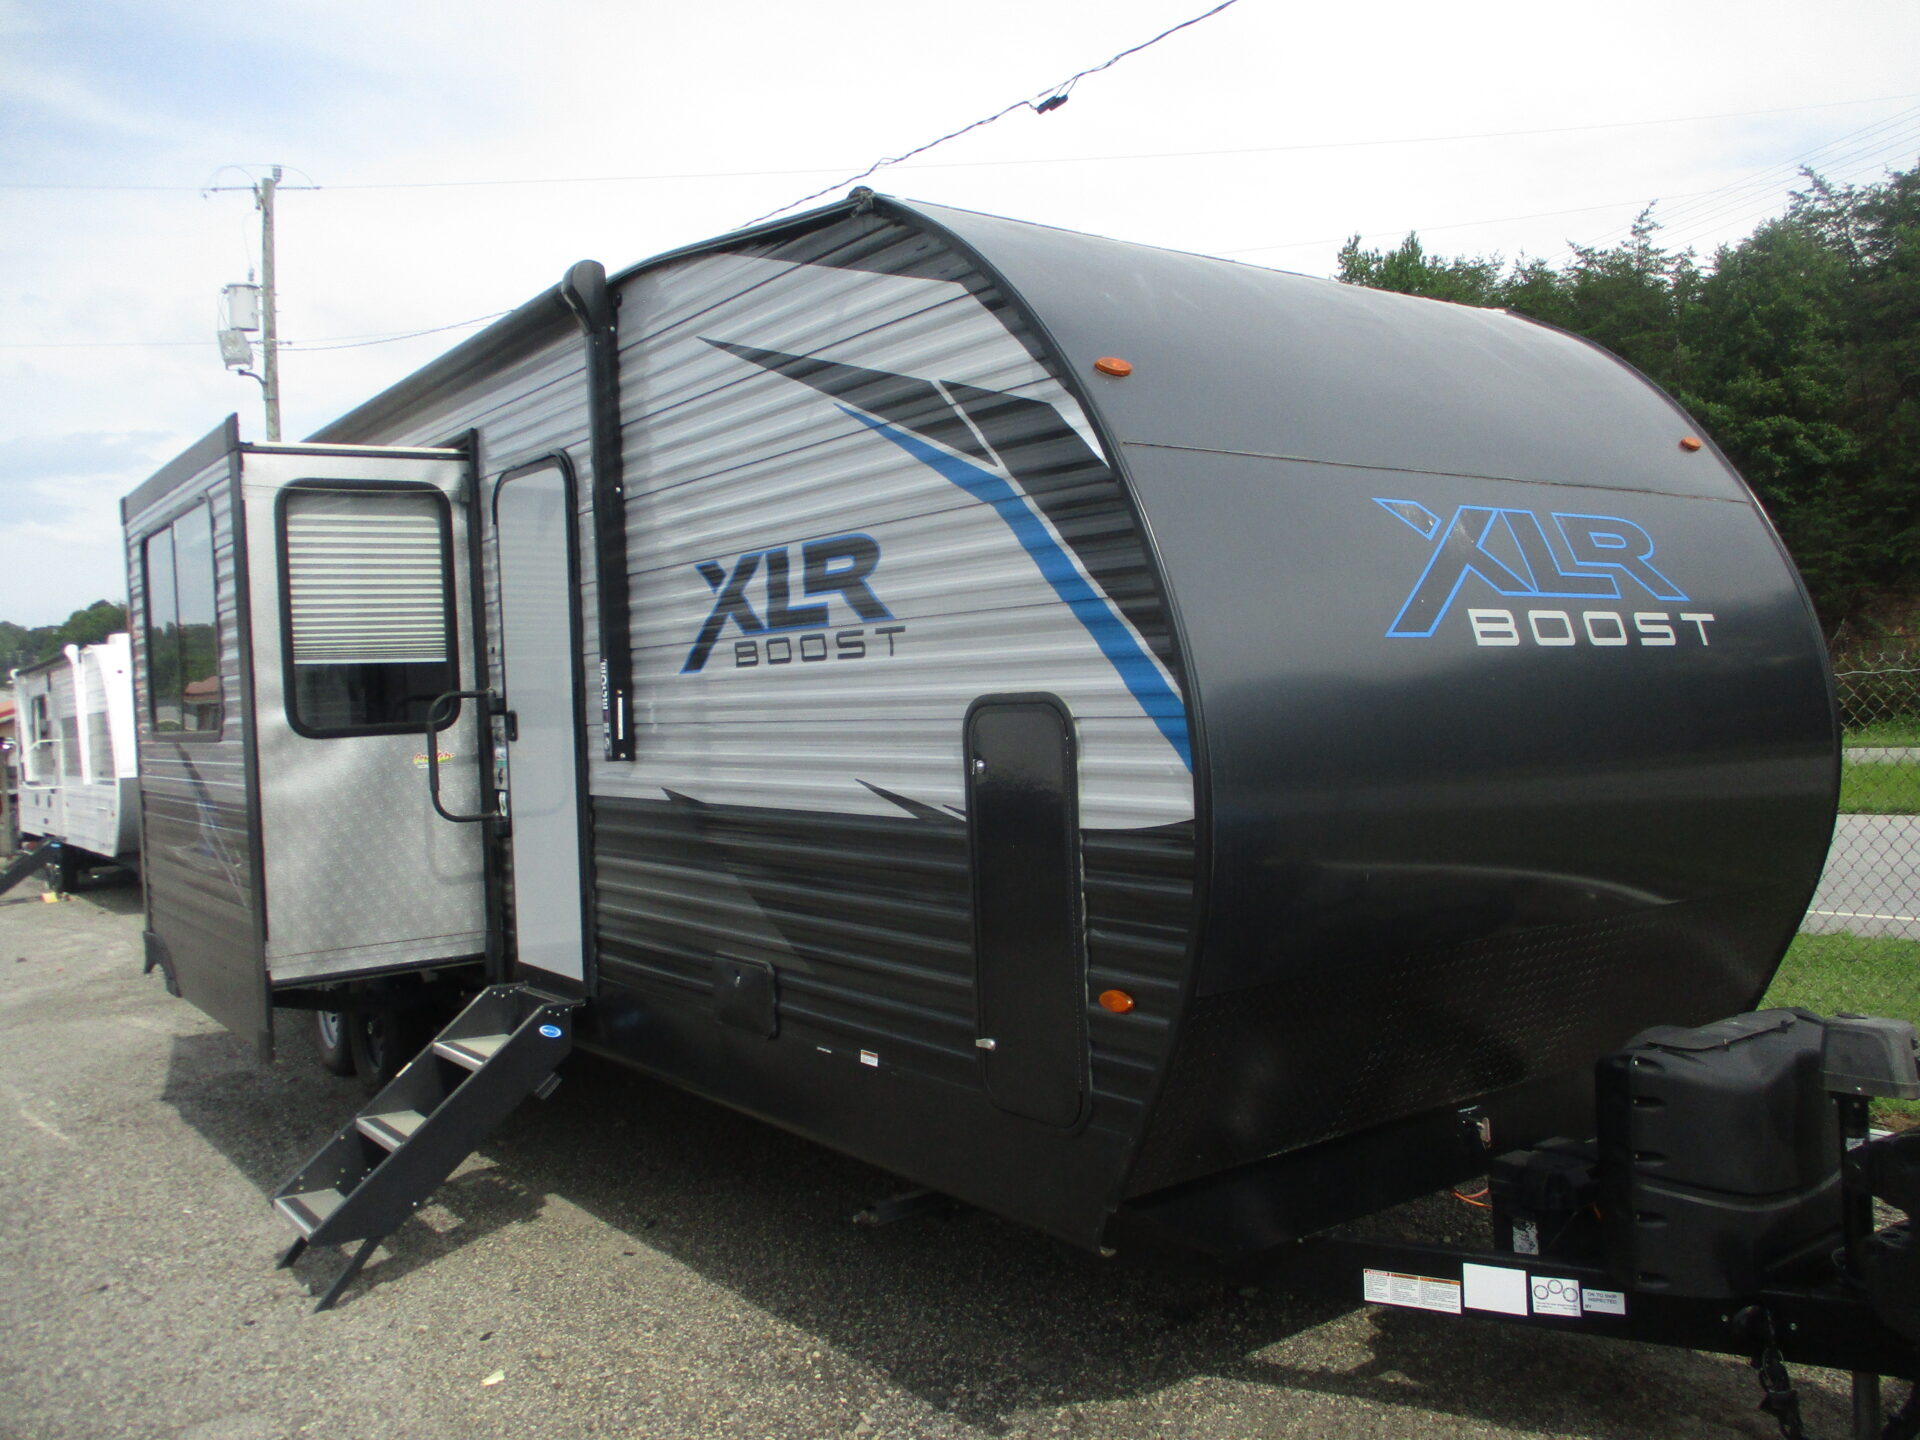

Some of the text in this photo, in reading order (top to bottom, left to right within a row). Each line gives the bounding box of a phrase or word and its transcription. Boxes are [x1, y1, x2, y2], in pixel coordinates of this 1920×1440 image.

[679, 533, 896, 674] XLR
[1371, 497, 1691, 638] XLR
[734, 625, 906, 668] BOOST
[1468, 608, 1715, 646] BOOST
